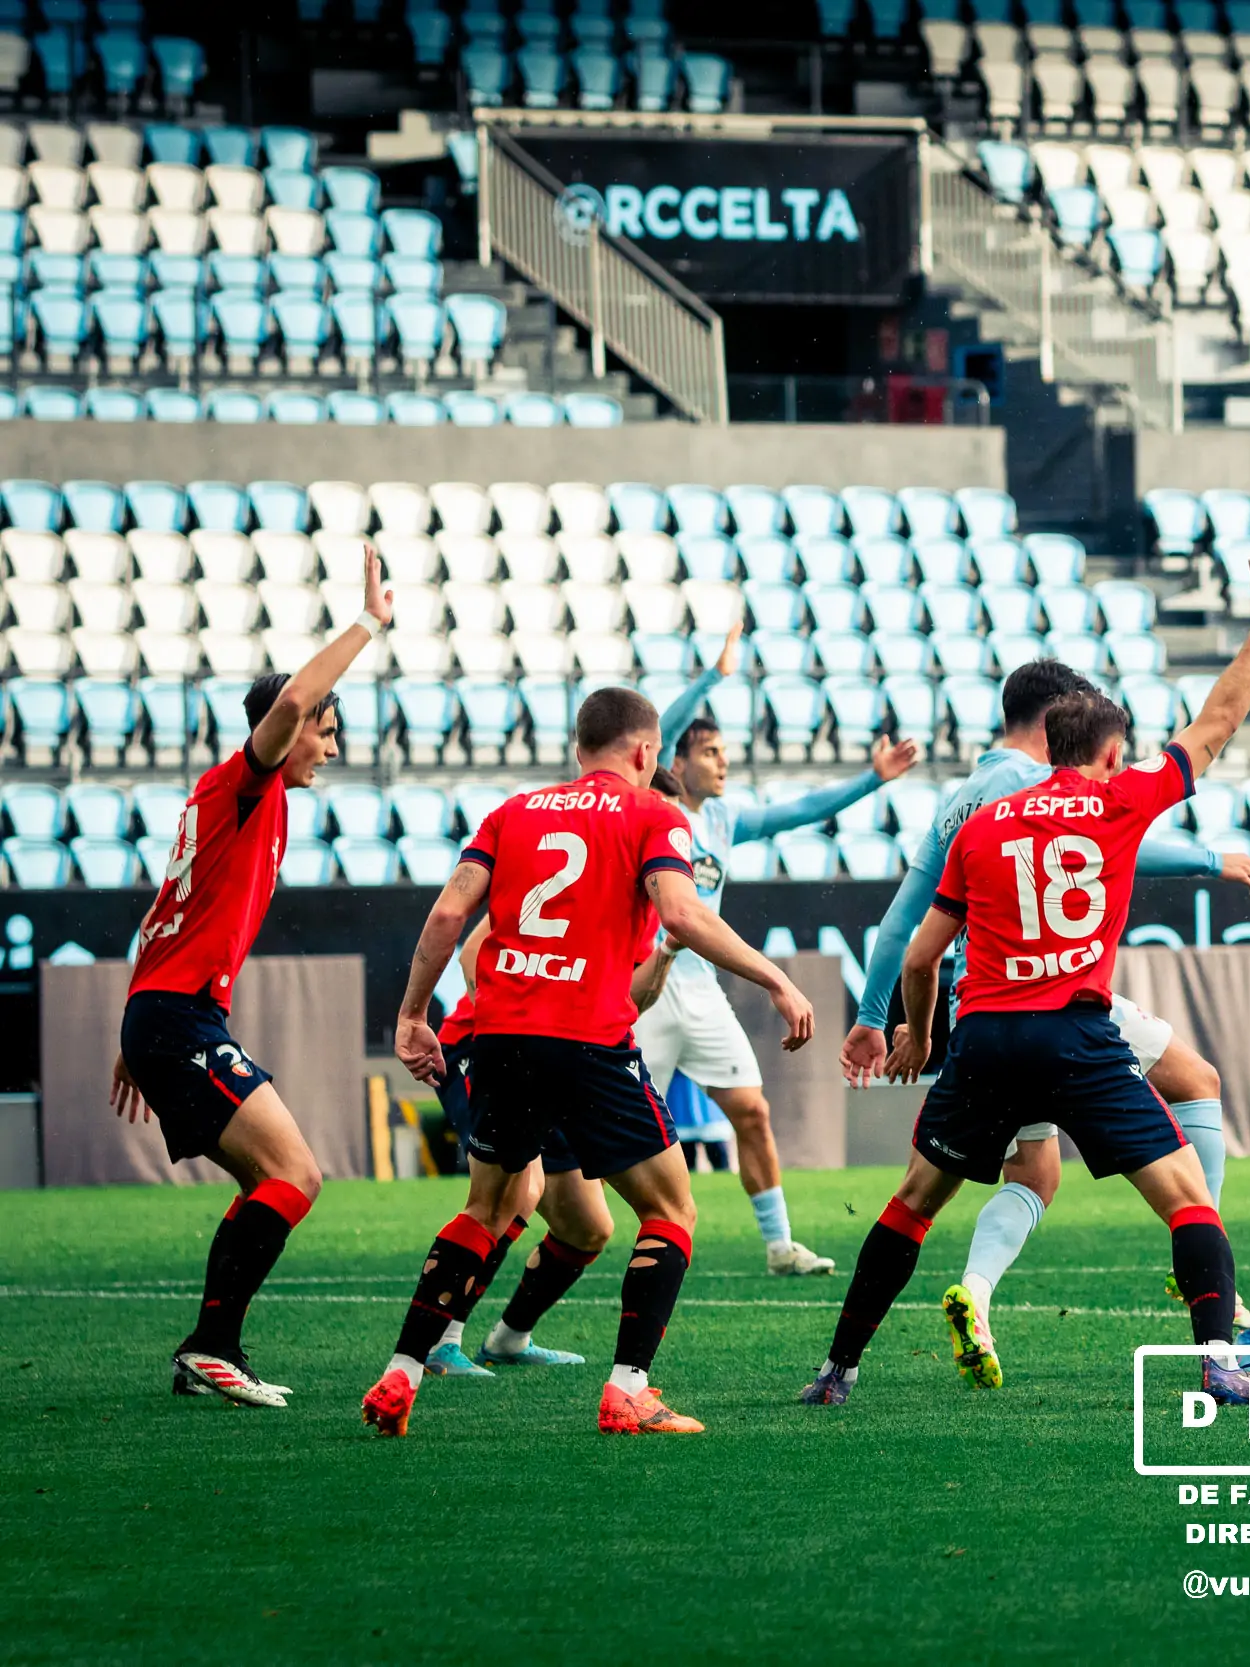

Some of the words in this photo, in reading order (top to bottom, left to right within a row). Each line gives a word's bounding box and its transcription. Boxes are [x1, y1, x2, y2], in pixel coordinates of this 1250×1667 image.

[525, 792, 596, 811] DIEGO
[597, 793, 622, 812] M.
[994, 801, 1015, 821] D.
[1022, 796, 1104, 818] ESPEJO
[519, 832, 588, 938] 2
[1001, 834, 1106, 940] 18
[495, 949, 587, 982] DIGI
[1005, 939, 1105, 981] DIGI
